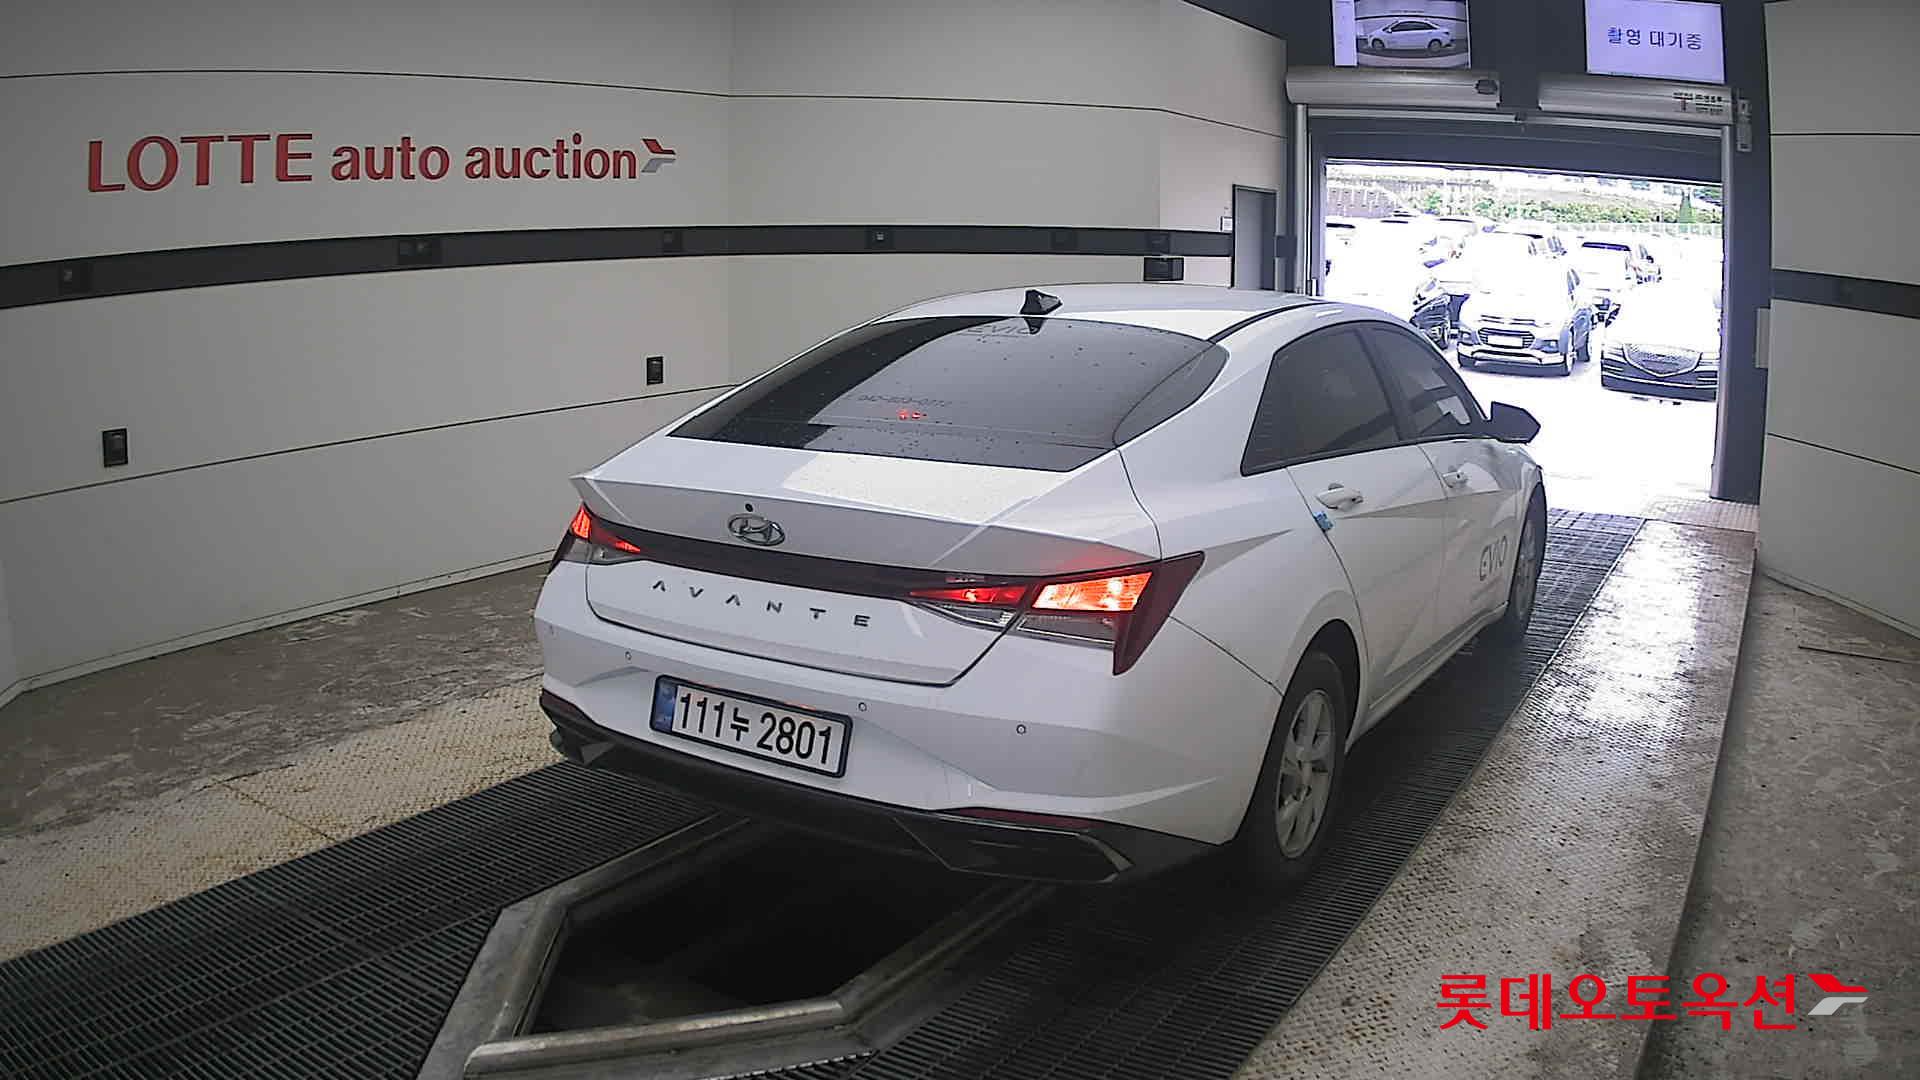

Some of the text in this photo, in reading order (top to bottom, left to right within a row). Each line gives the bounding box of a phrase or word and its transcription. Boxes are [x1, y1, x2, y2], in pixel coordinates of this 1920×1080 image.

[1649, 30, 1702, 50] 대기중
[87, 133, 638, 193] LOTTE auto auction
[652, 579, 870, 627] AVANTE
[679, 692, 833, 765] 111누 2801
